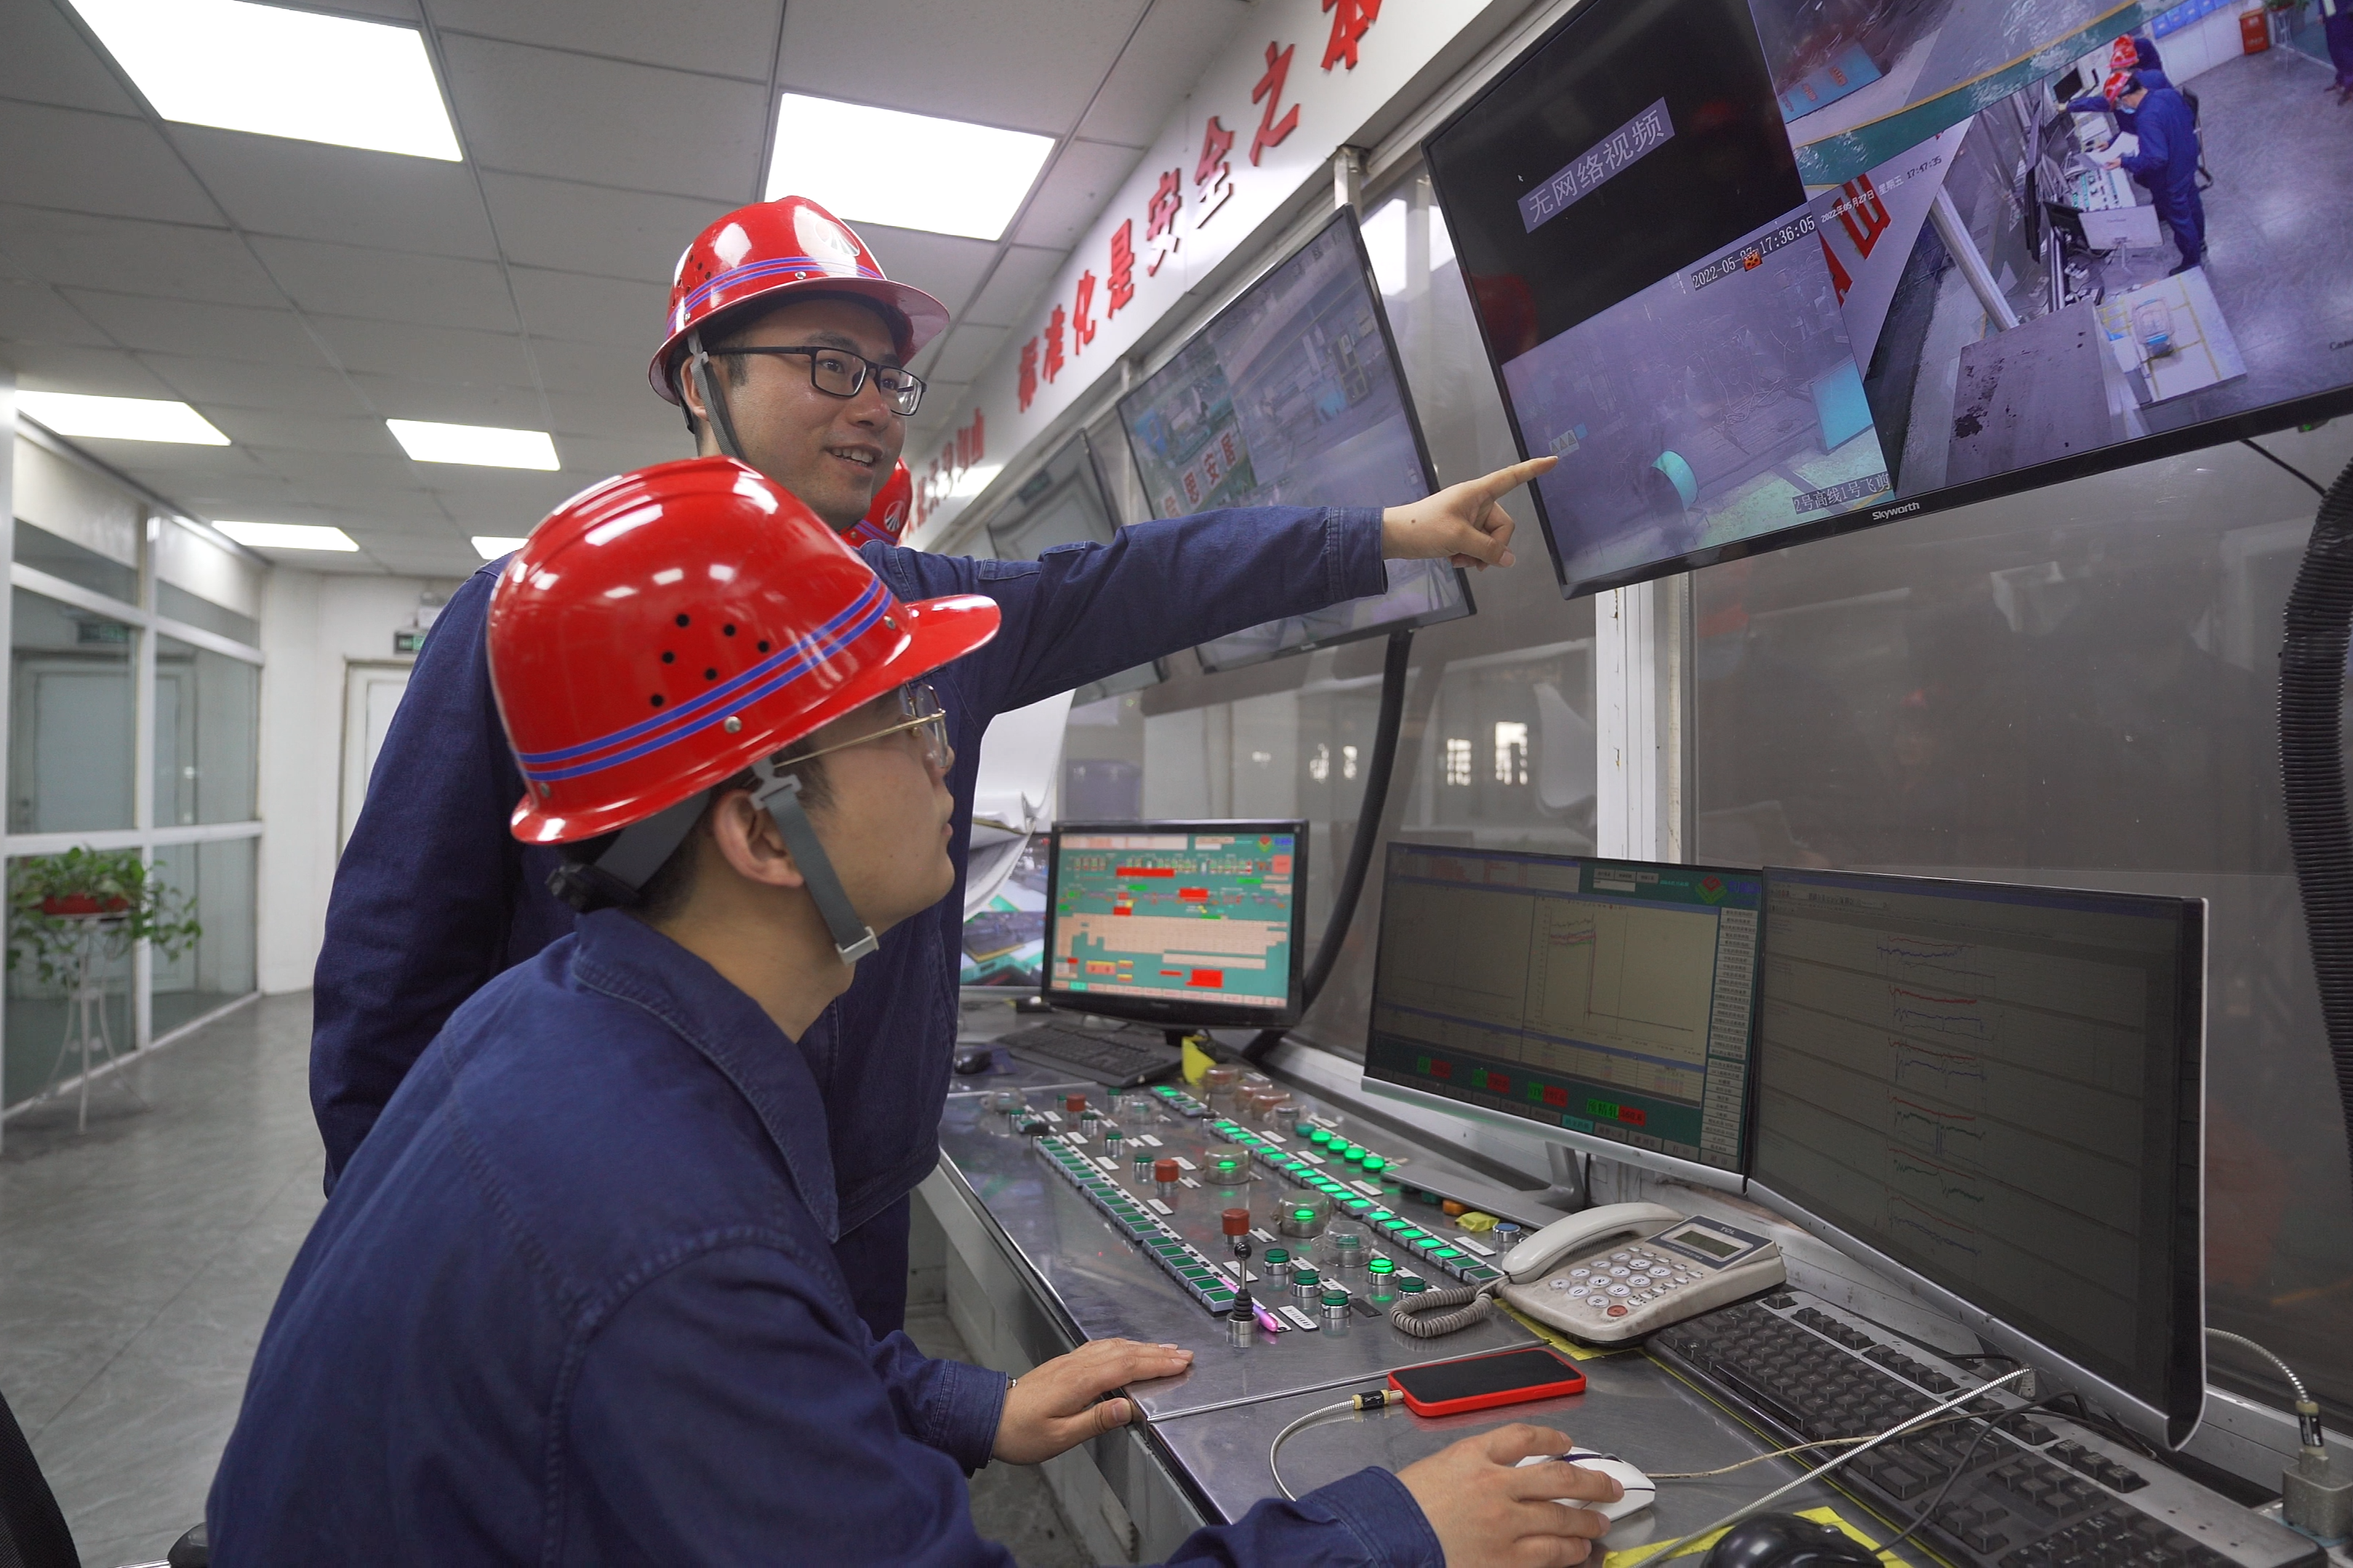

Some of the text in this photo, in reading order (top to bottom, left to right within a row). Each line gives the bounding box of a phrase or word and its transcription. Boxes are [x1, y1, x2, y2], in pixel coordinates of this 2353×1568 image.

[1528, 108, 1665, 222] 无网络视频
[1878, 175, 1904, 196] 星期五
[1907, 156, 1942, 179] 17:47:35
[1760, 214, 1815, 255] 17:36:05
[1794, 473, 1891, 512] 2号高线1号飞剪
[1872, 502, 1920, 520] Skyworth
[1720, 1226, 1735, 1235] TCL
